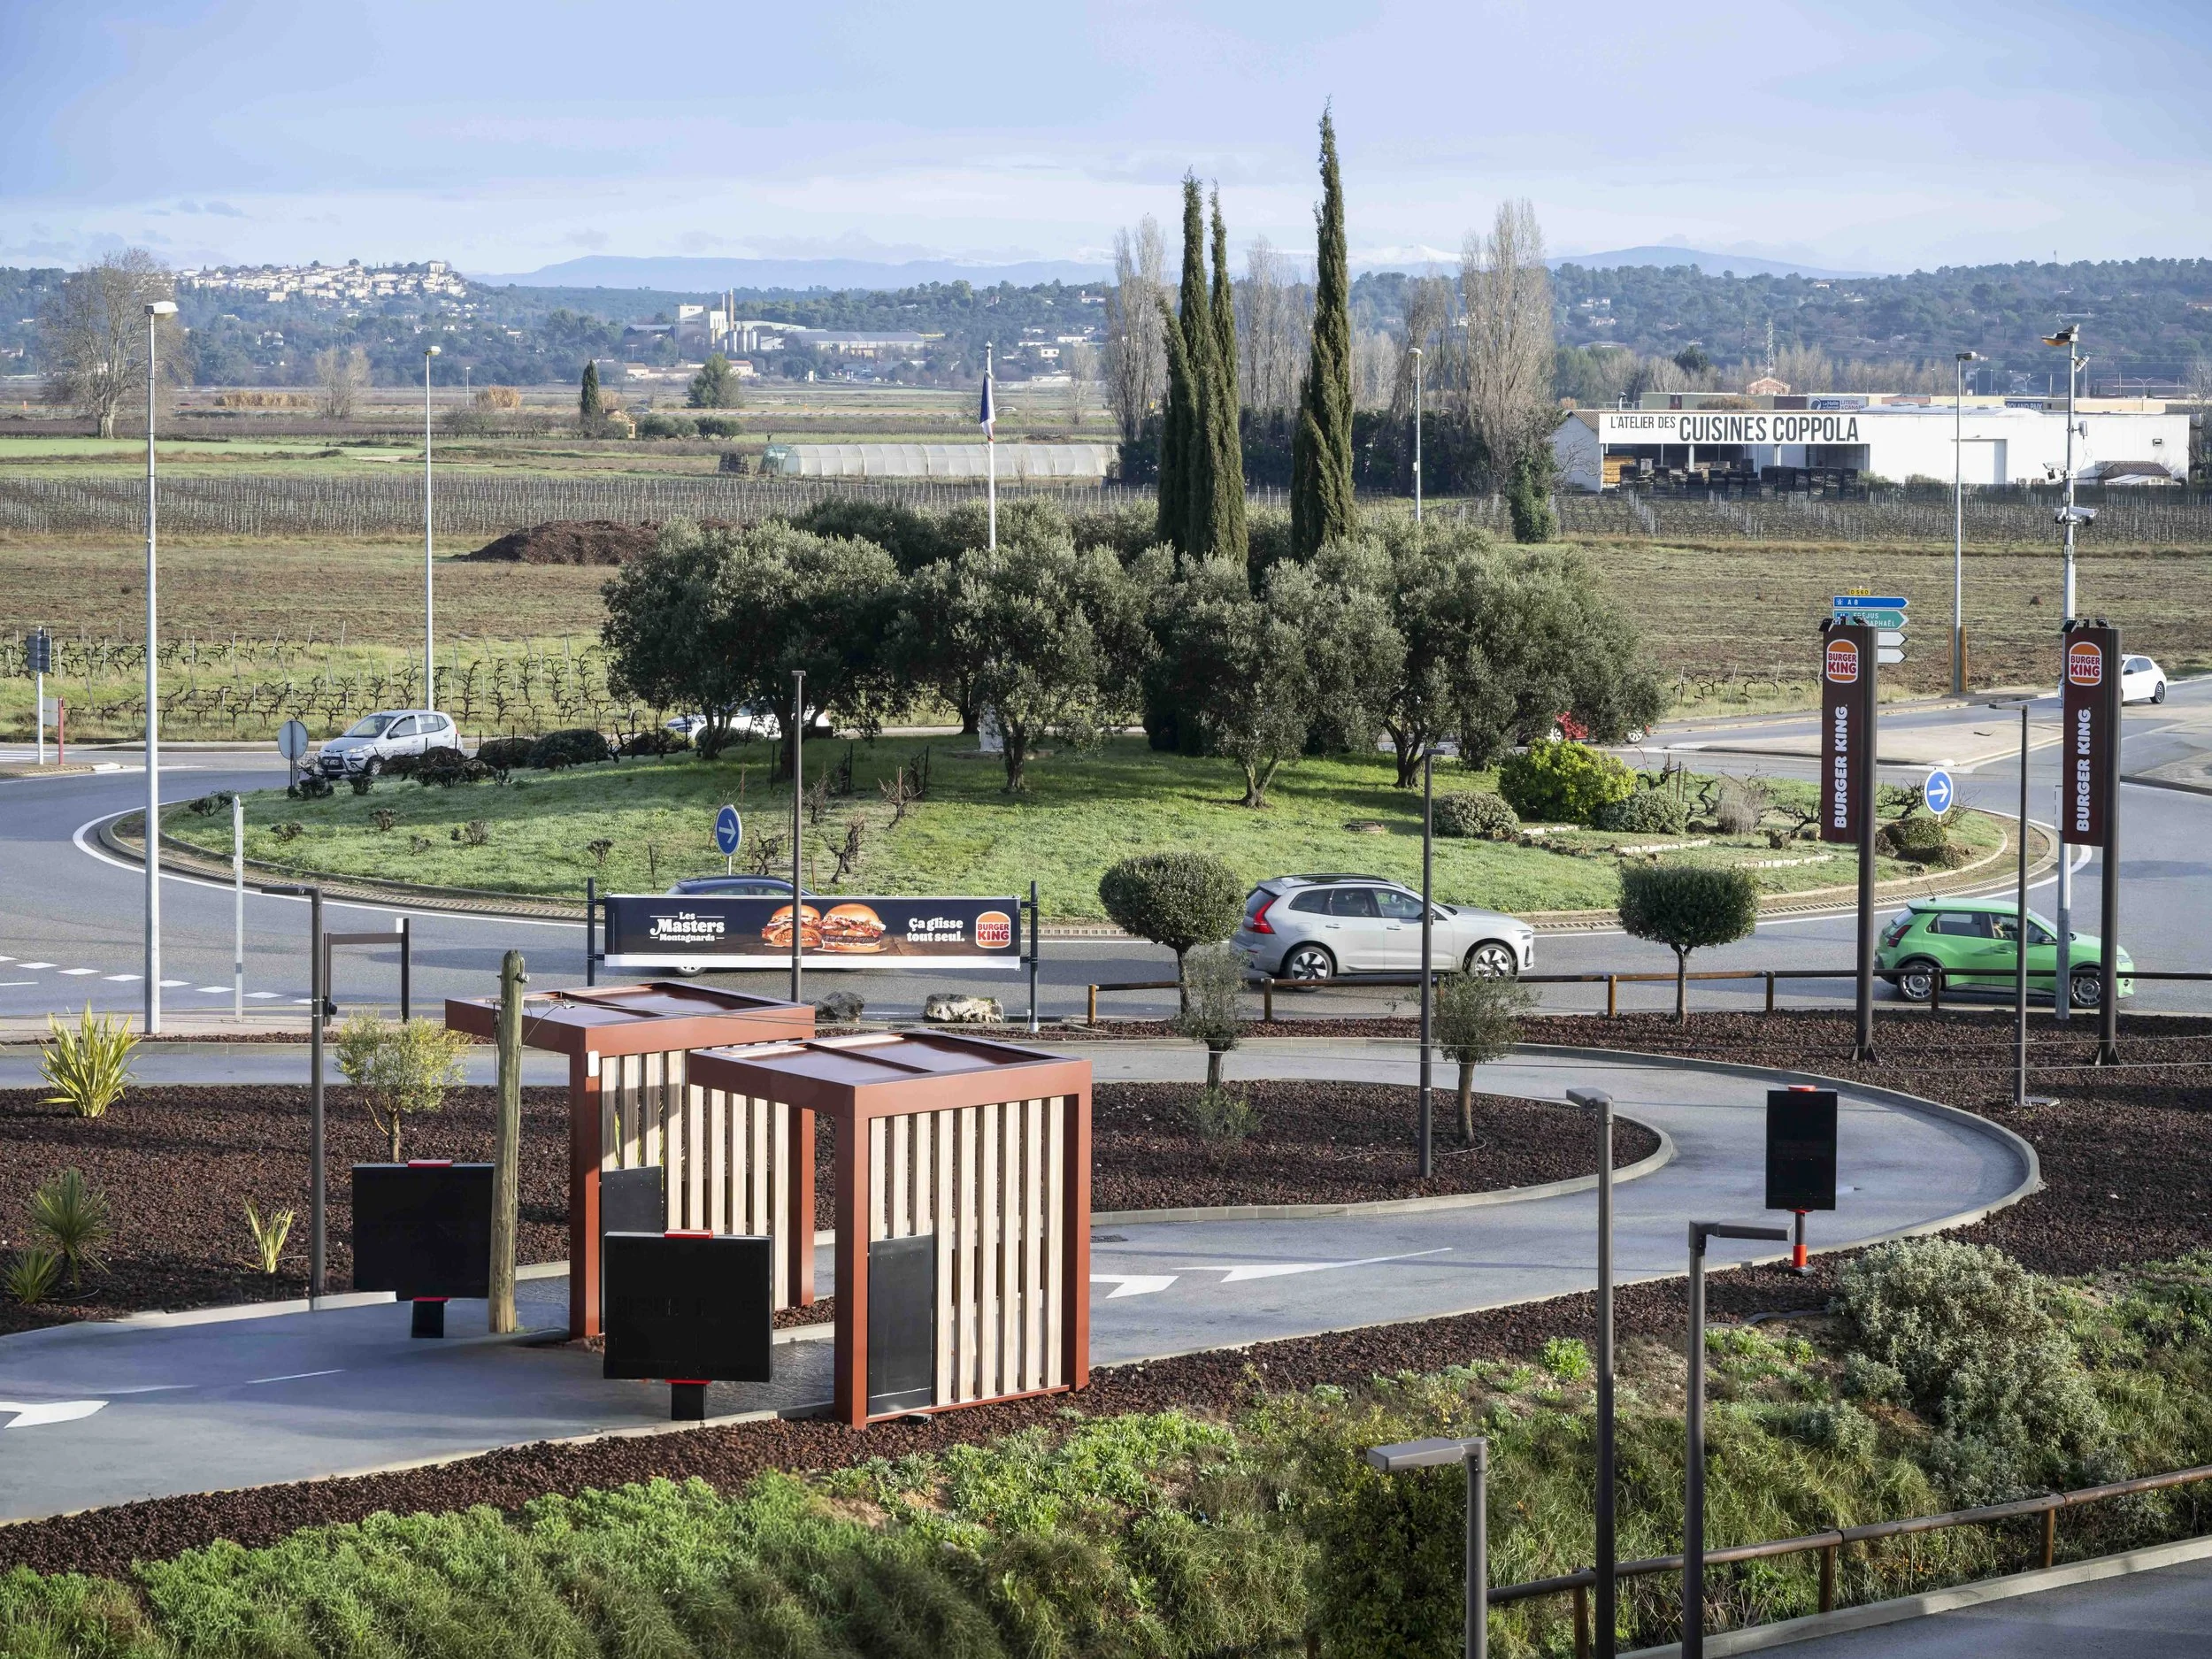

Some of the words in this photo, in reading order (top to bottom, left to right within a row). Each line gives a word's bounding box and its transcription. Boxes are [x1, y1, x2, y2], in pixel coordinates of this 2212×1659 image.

[1610, 416, 1655, 429] L'ATELIER
[1658, 416, 1676, 429] DES
[1679, 416, 1767, 442] CUISINES
[1773, 416, 1859, 442] COPPOLA
[1828, 653, 1857, 663] BURGER
[2070, 655, 2101, 665] BURGER
[1828, 662, 1857, 674] KING
[2070, 664, 2101, 677] KING
[1834, 756, 1847, 828] BURGER
[2077, 758, 2090, 832] BURGER
[679, 911, 695, 920] Les
[649, 918, 725, 935] Masters
[908, 918, 926, 932] Ça
[926, 917, 964, 932] glisse
[659, 933, 716, 943] Montagnards
[907, 932, 933, 942] tout
[934, 930, 965, 942] seul.
[978, 931, 1010, 941] KING
